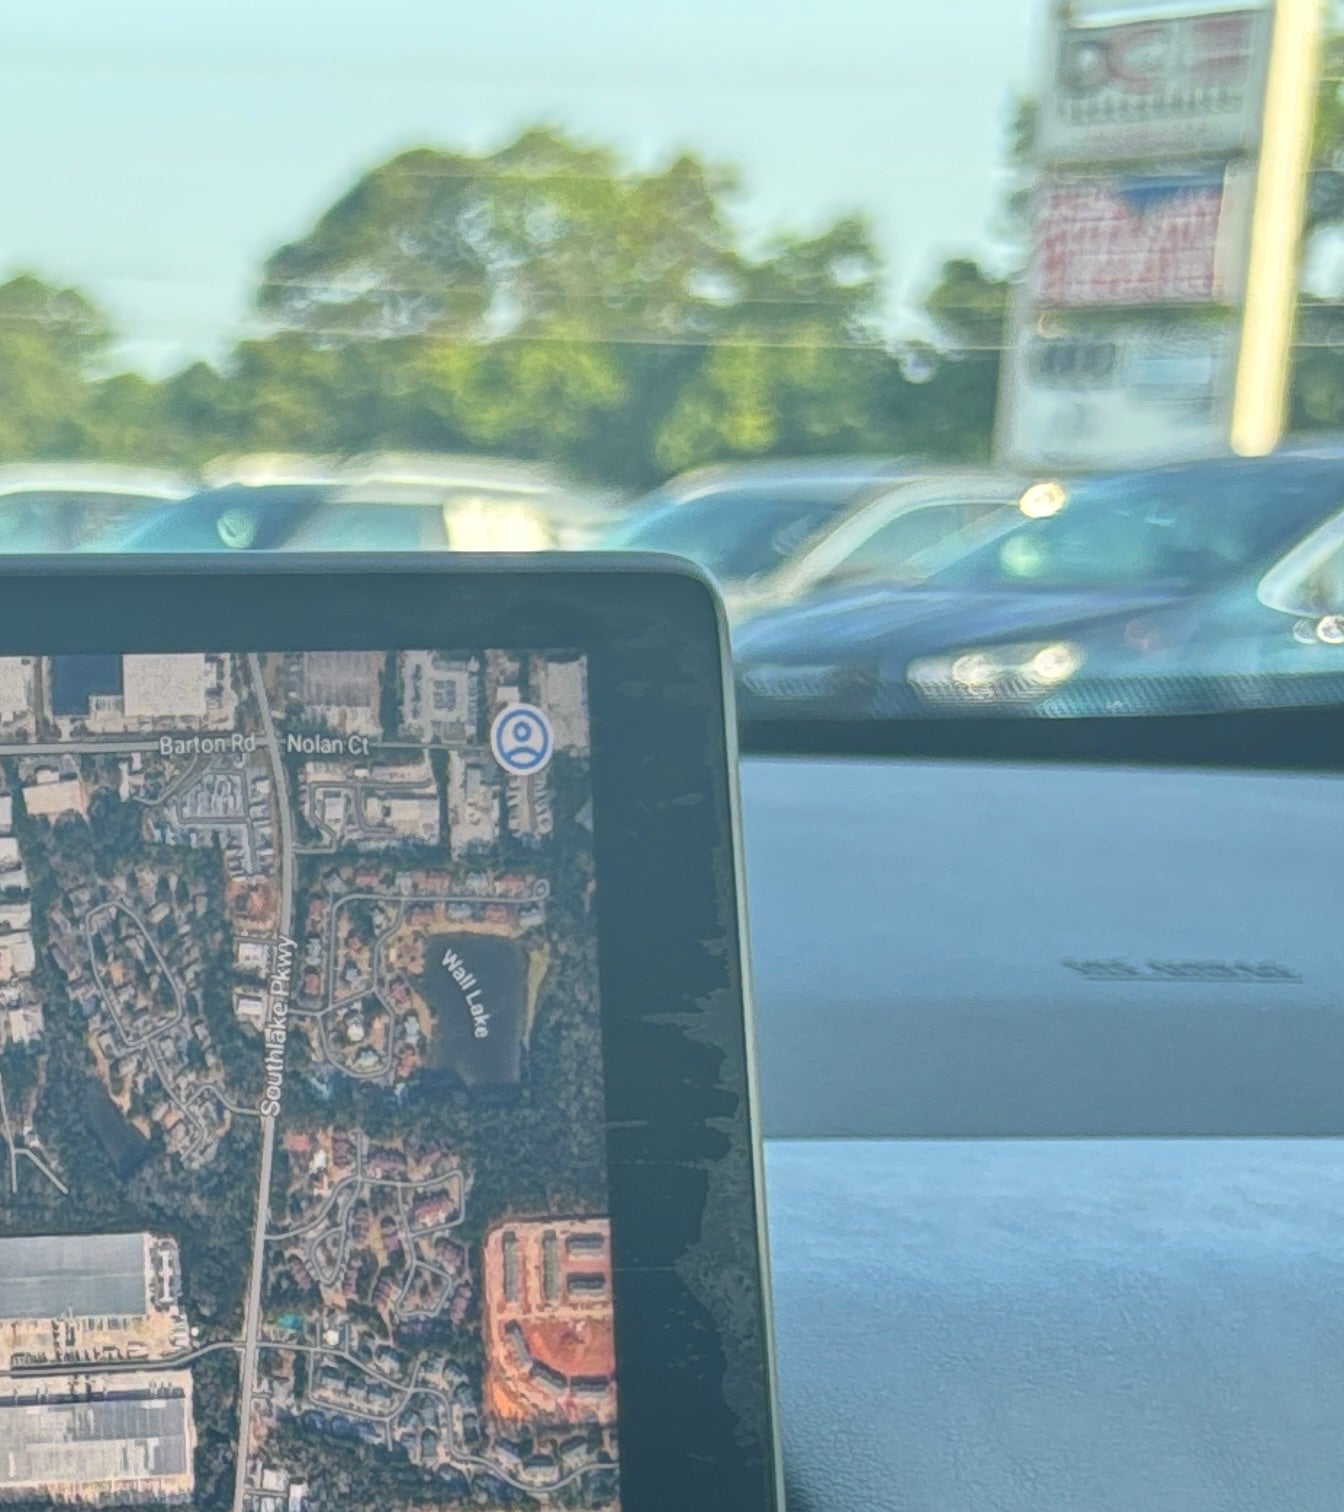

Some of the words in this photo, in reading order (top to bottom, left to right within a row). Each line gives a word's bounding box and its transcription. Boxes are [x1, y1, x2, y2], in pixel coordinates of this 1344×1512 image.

[159, 735, 226, 755] Barton
[231, 733, 256, 752] Rd
[287, 734, 343, 754] Nolan
[348, 735, 369, 755] Ct
[270, 935, 298, 996] Pkwy
[441, 948, 477, 991] Wall
[465, 988, 490, 1039] Lake
[261, 1000, 288, 1118] Southlake
